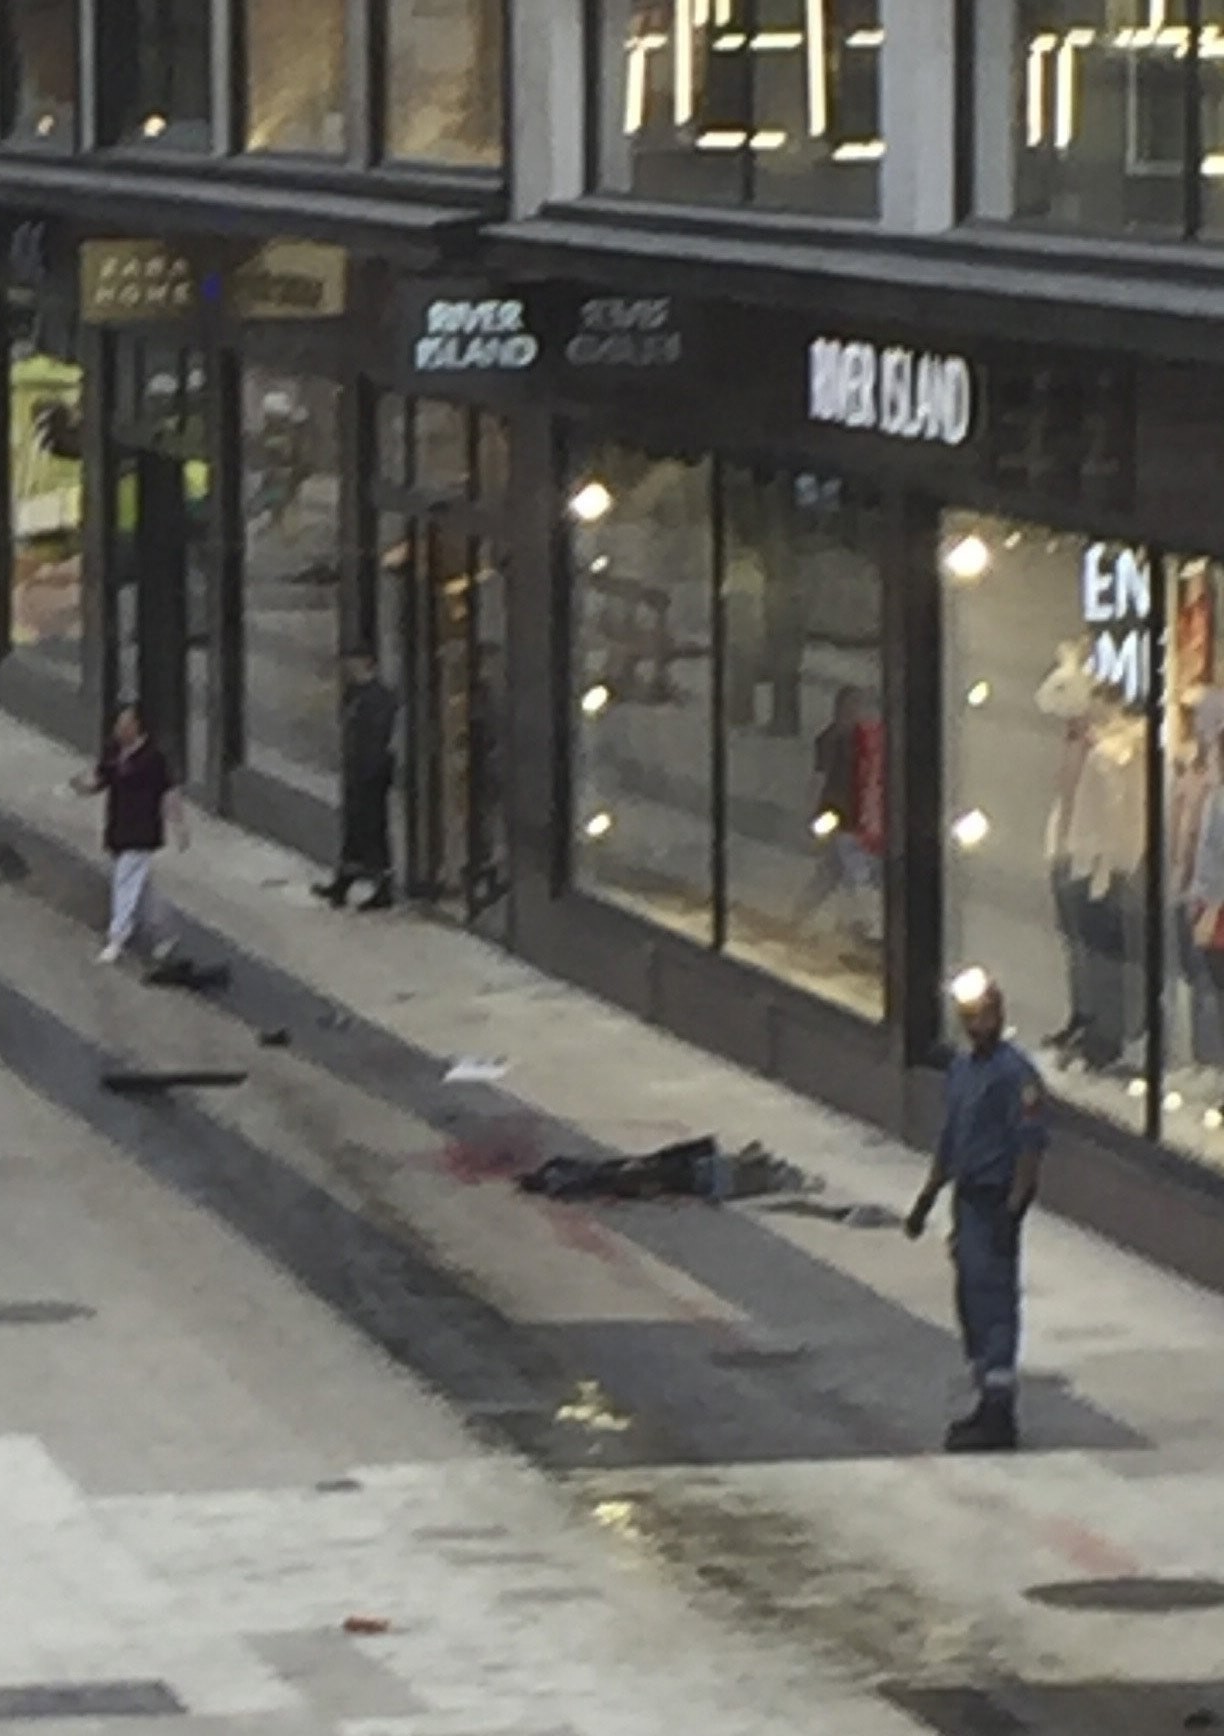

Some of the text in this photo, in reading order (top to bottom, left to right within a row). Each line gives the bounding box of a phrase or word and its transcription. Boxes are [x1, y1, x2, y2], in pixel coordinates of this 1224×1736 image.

[427, 300, 524, 334] RIVER
[415, 335, 538, 370] ISLAND
[808, 337, 971, 447] RIVER ISLAND
